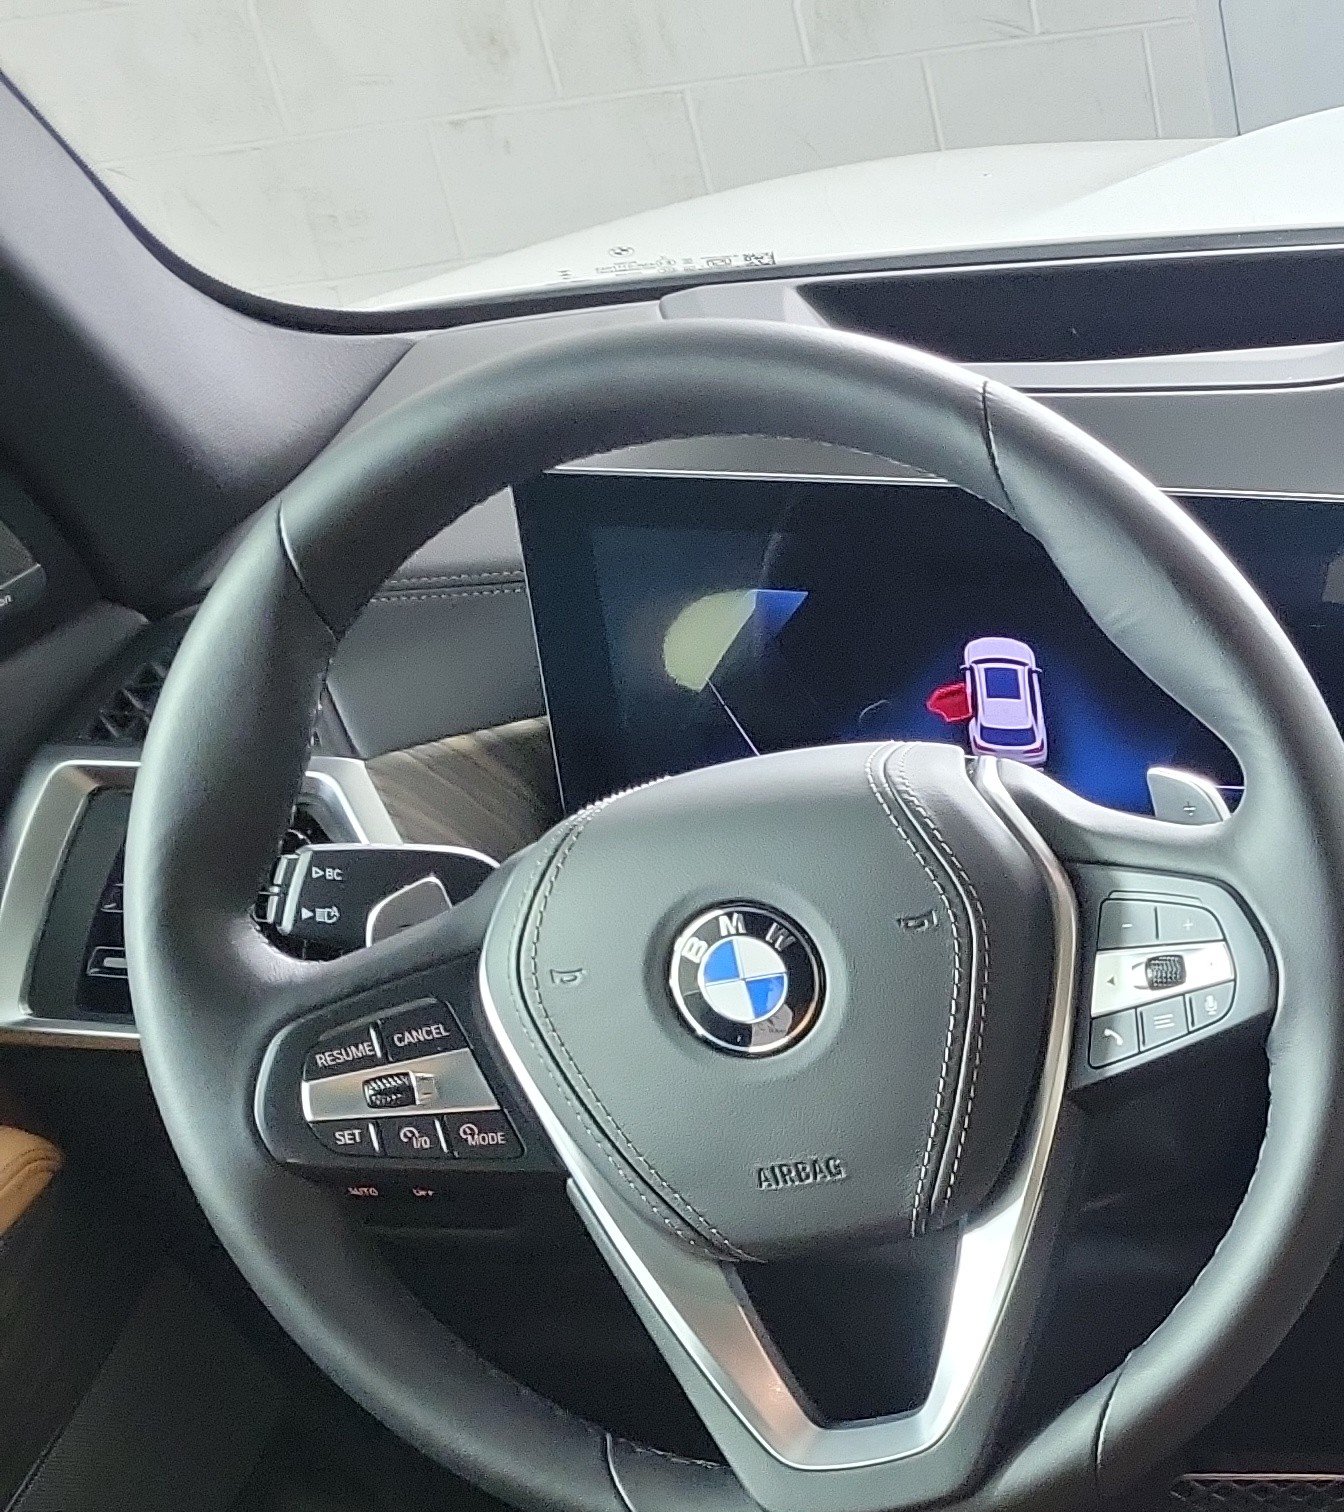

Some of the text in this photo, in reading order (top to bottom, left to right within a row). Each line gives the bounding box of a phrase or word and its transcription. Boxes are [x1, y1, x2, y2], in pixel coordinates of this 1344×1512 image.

[325, 867, 344, 881] BC
[679, 912, 797, 965] BMW
[392, 1022, 451, 1048] CANCEL
[315, 1041, 376, 1068] RESUME
[334, 1128, 362, 1146] SET
[467, 1132, 507, 1147] MODE
[756, 1156, 847, 1192] AIRBAG
